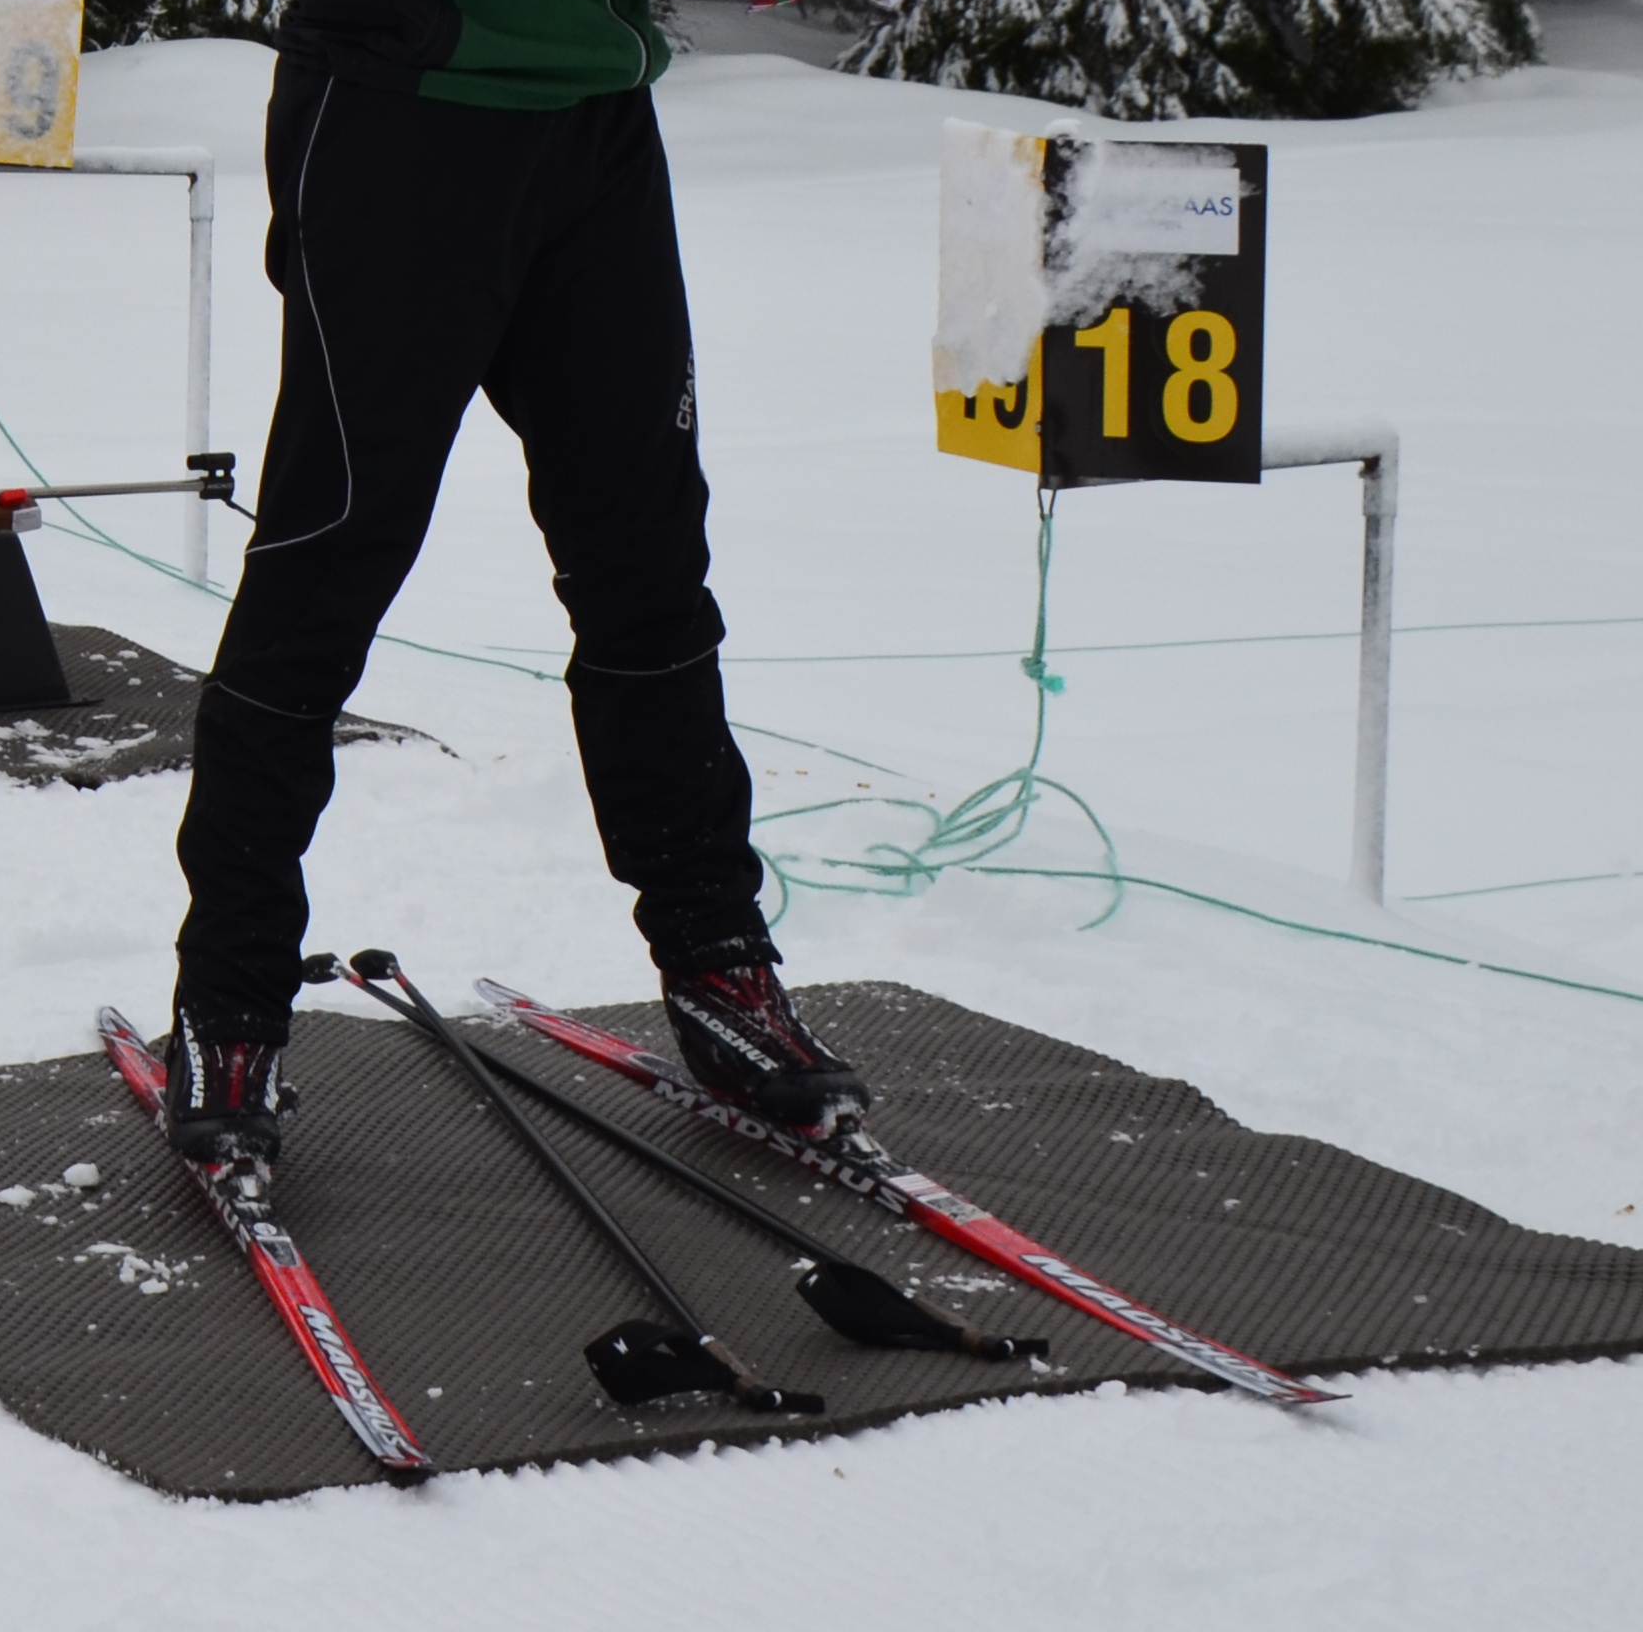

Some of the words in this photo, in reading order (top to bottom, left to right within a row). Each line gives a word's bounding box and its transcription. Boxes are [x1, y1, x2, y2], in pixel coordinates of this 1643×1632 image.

[1075, 308, 1240, 444] 18
[672, 994, 779, 1071] MADSHUS
[654, 1080, 908, 1216] MADSHUS
[299, 1304, 409, 1448] MADSHUS
[1020, 1253, 1271, 1384] MADSHUS
